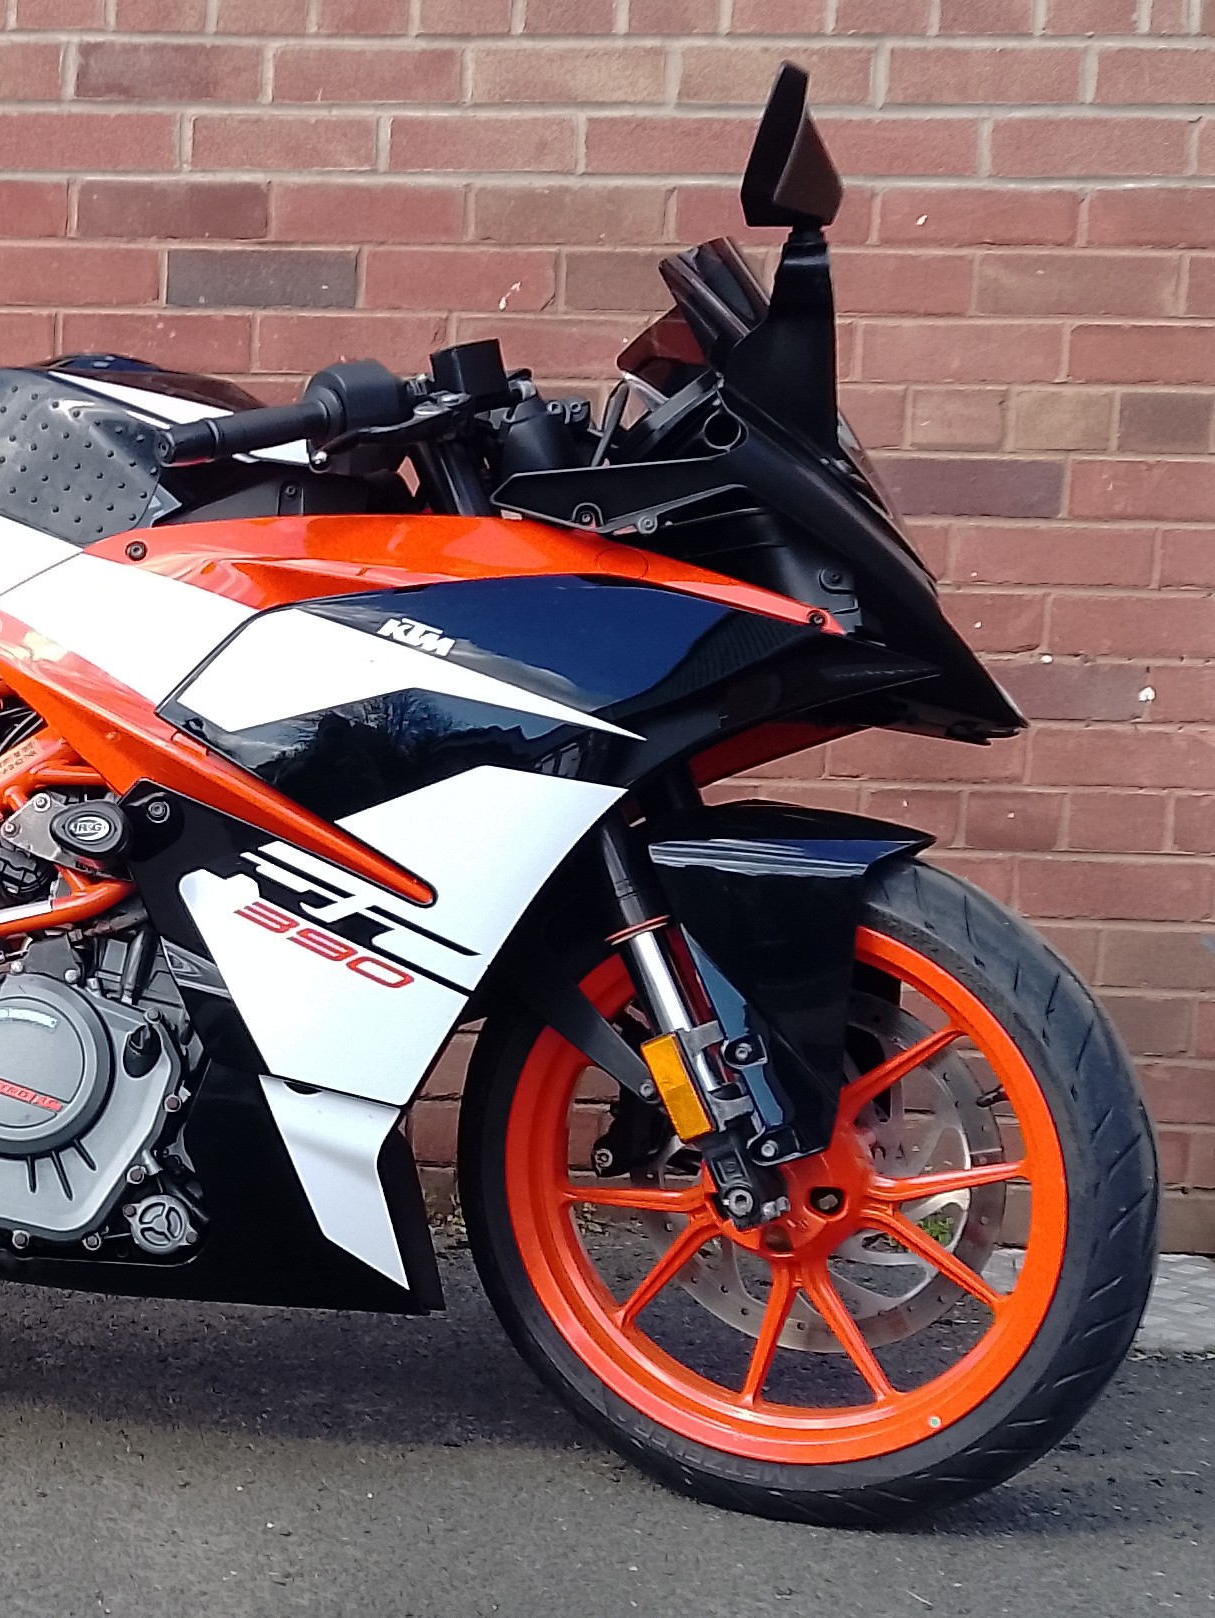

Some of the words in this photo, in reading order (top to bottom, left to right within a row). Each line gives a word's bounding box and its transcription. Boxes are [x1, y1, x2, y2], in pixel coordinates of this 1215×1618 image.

[376, 617, 456, 658] KTM
[232, 901, 415, 989] 390
[632, 1417, 787, 1485] METZELER
